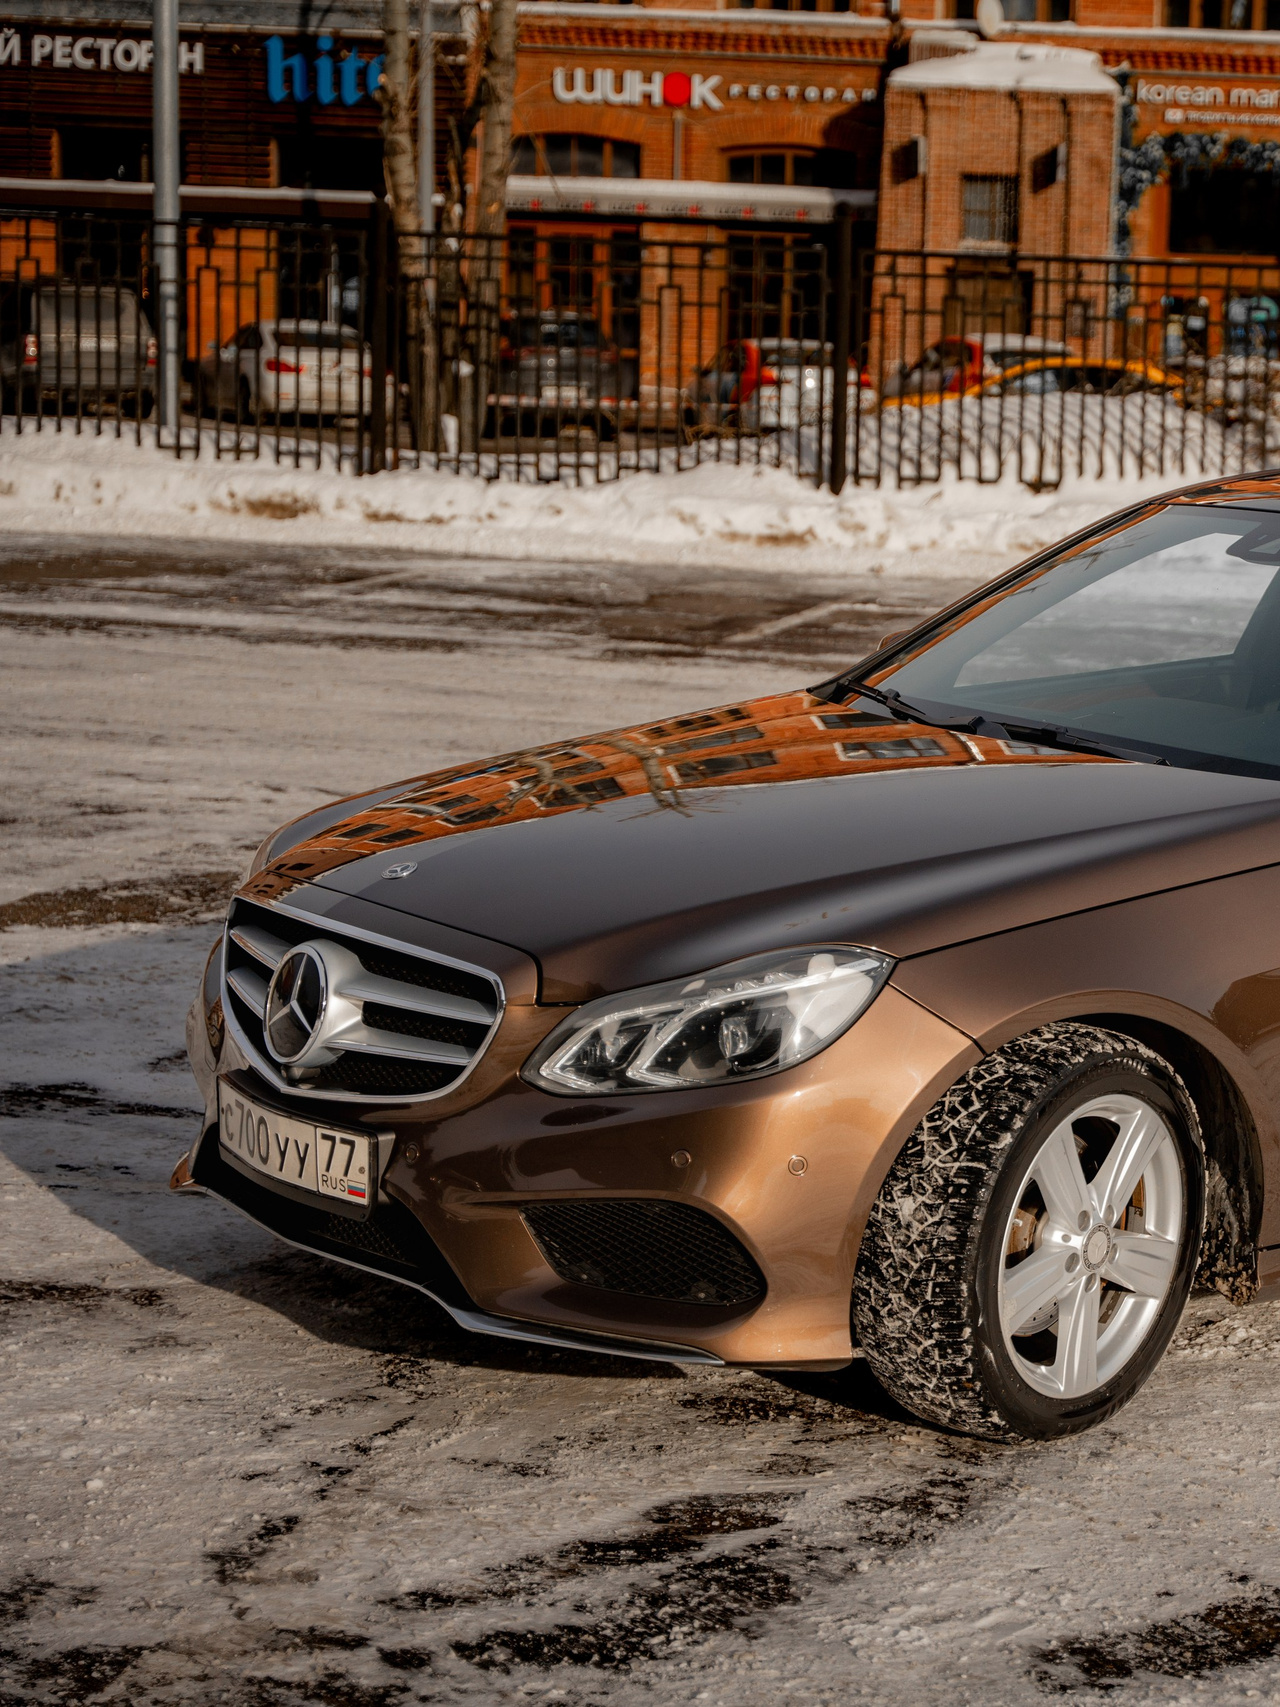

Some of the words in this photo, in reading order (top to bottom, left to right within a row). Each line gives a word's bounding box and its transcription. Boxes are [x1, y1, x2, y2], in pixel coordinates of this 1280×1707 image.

[31, 34, 204, 74] РЕСТОРН
[1137, 79, 1224, 106] korean
[321, 1133, 356, 1177] 77
[321, 1174, 346, 1193] RUS
